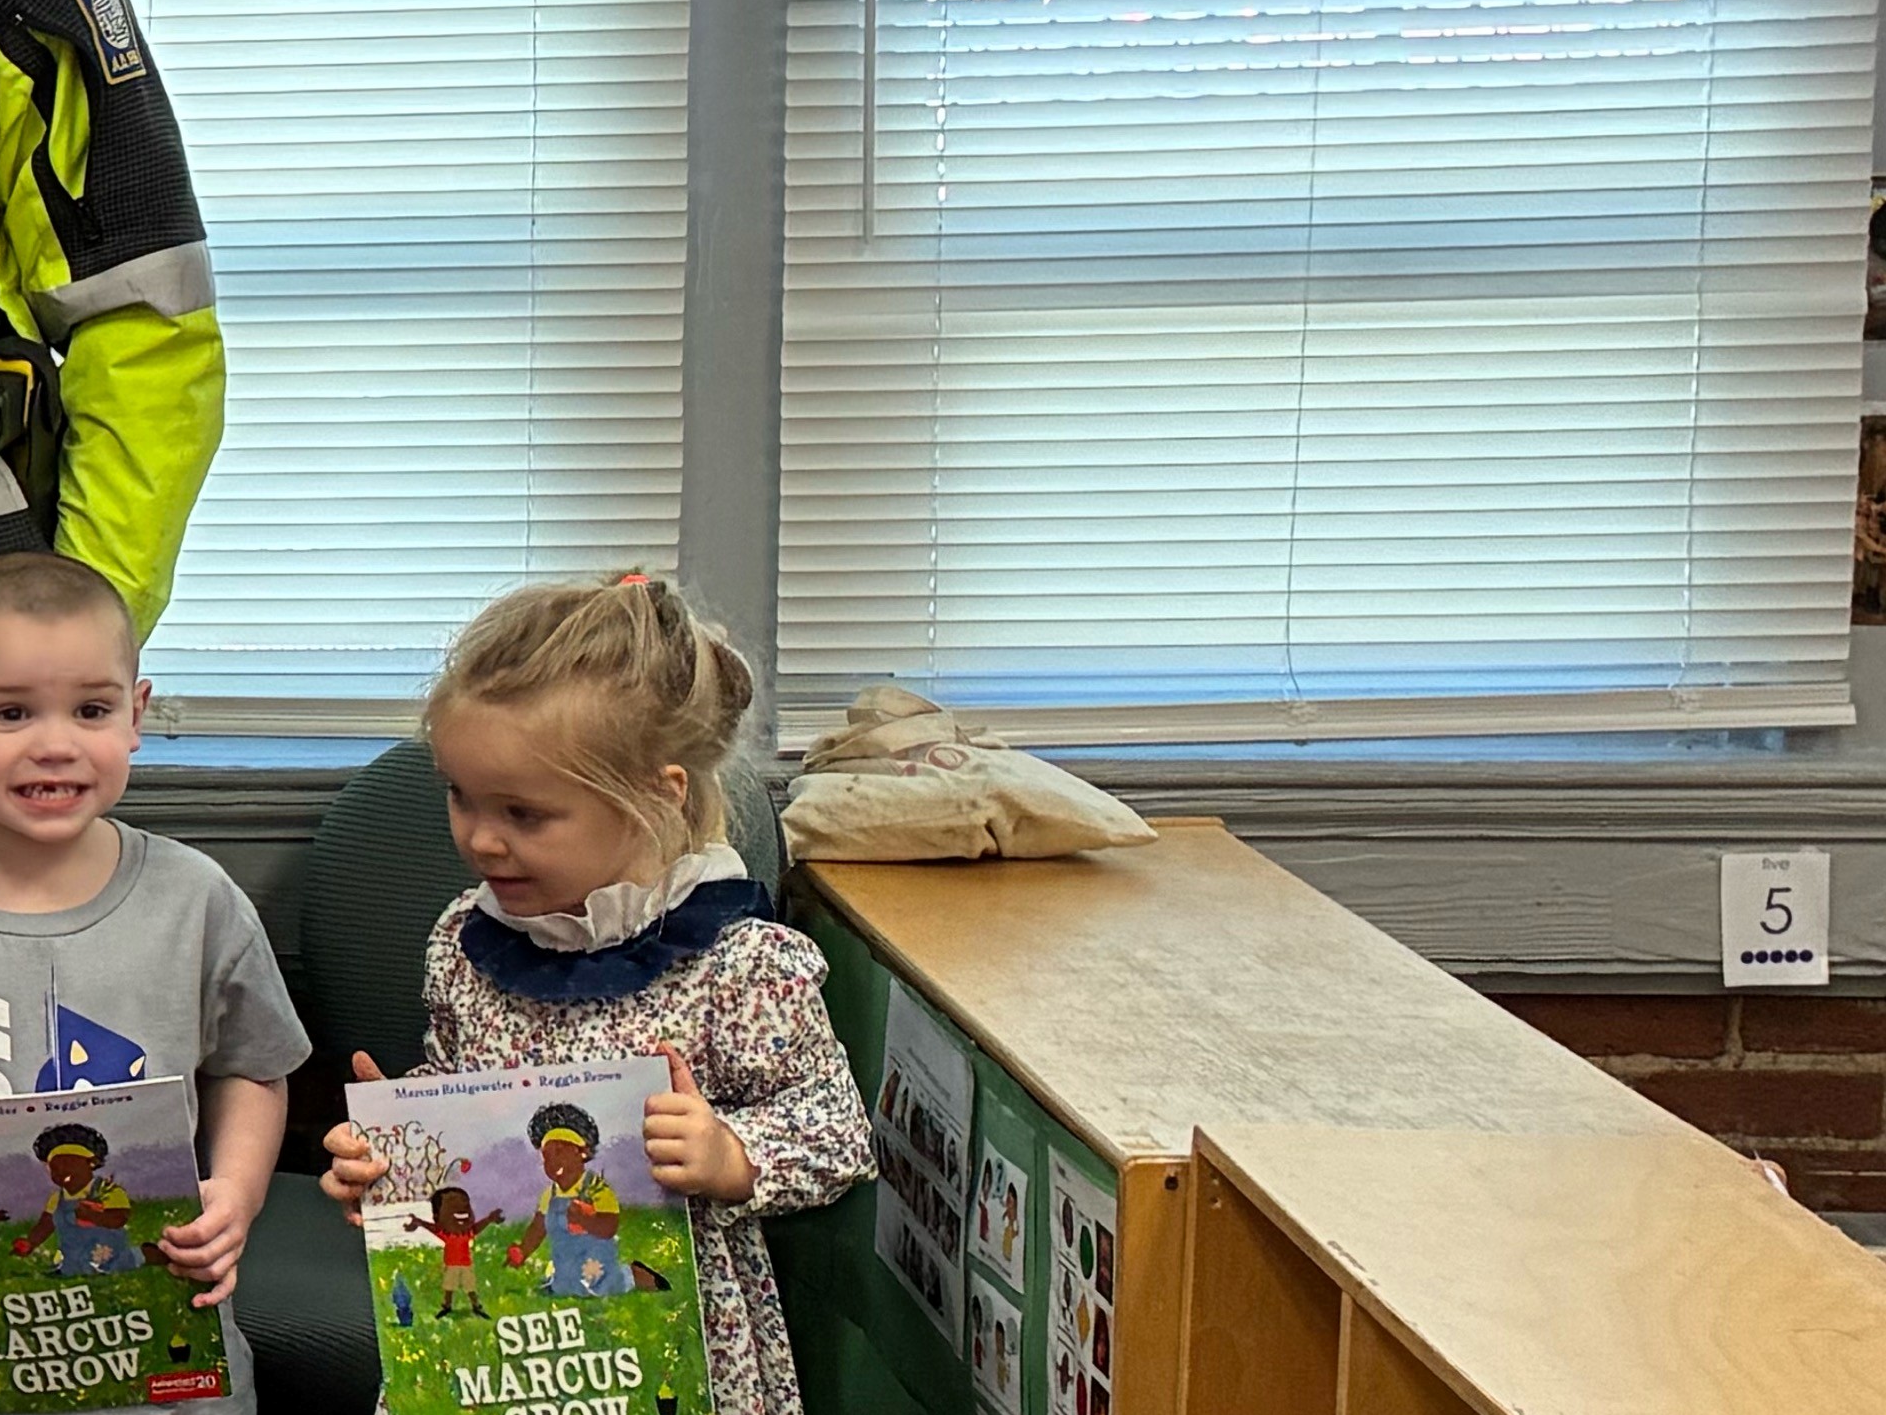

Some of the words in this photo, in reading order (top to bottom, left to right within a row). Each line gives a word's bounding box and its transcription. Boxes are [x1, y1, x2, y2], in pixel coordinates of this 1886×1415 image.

[1761, 858, 1791, 872] five
[1760, 886, 1794, 936] 5
[4, 1285, 94, 1324] SEE
[497, 1308, 585, 1355] SEE
[13, 1348, 139, 1393] GROW
[455, 1348, 642, 1405] MARCUS
